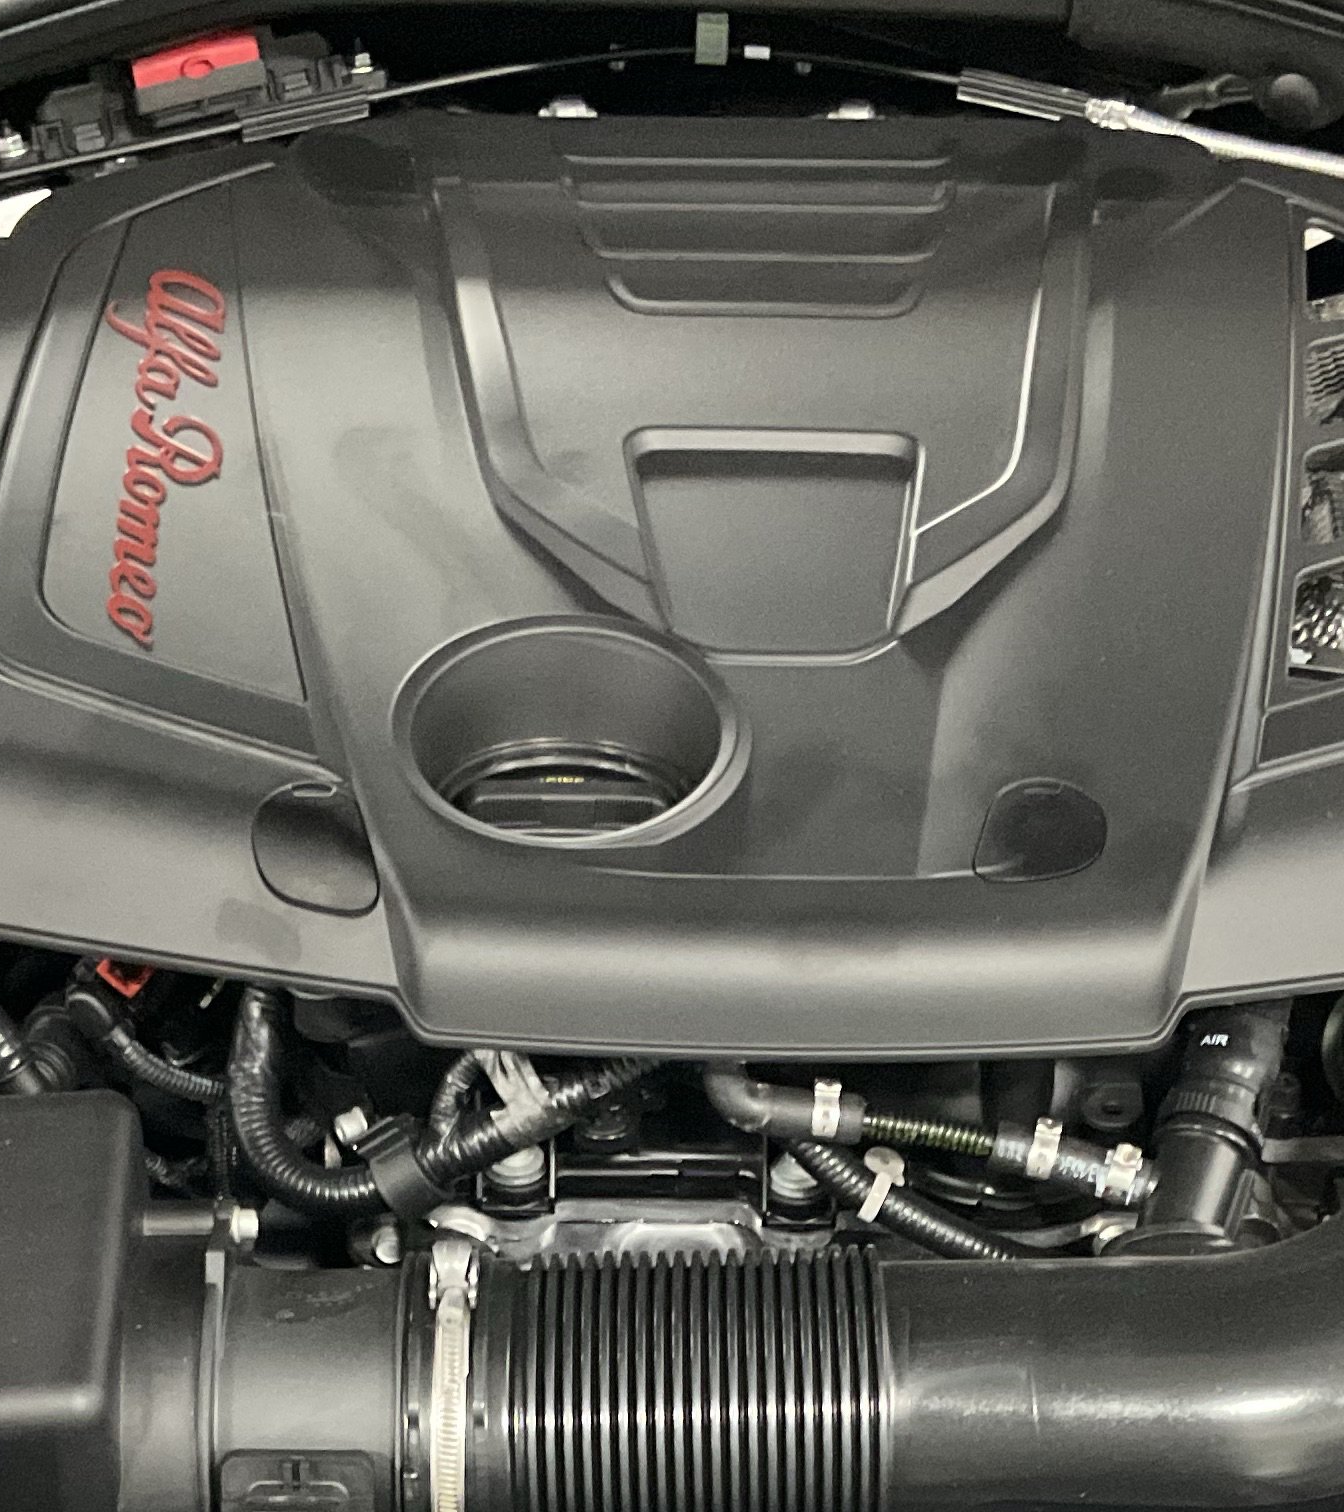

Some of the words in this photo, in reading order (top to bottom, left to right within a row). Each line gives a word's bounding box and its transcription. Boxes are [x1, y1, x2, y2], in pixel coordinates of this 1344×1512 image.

[107, 269, 225, 405] Alfa
[106, 404, 223, 648] Romeo
[1199, 1033, 1230, 1047] AIR
